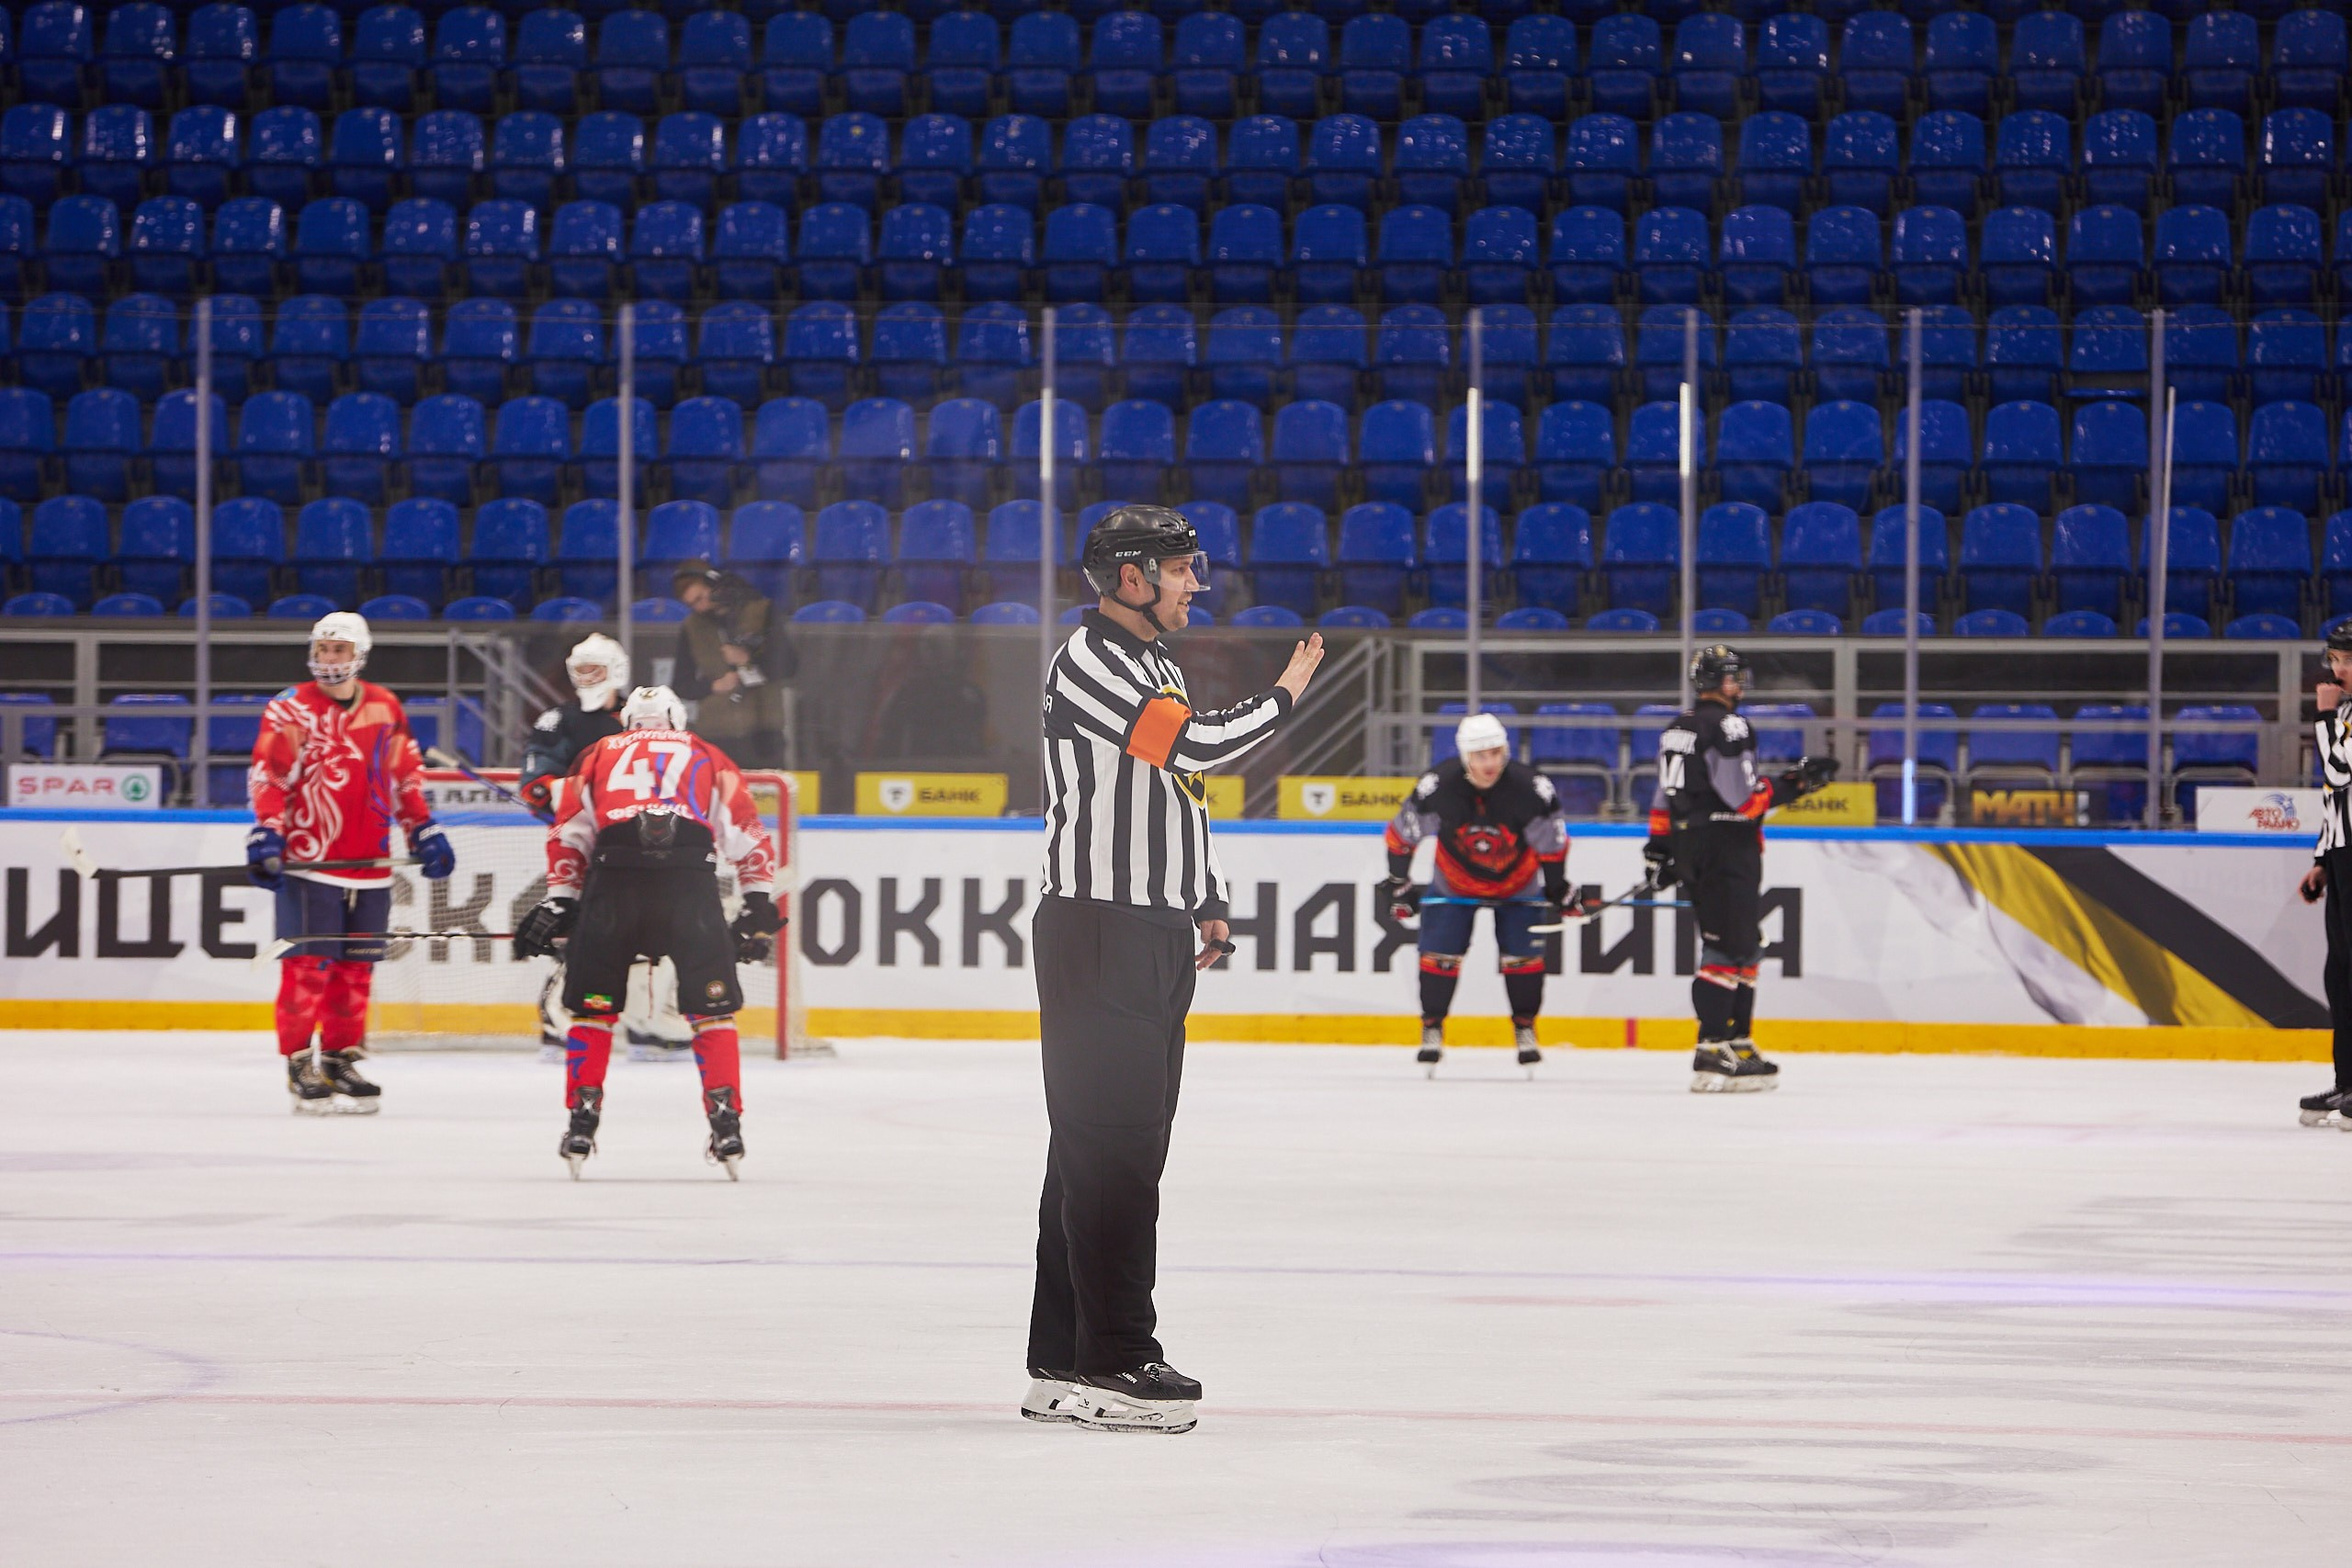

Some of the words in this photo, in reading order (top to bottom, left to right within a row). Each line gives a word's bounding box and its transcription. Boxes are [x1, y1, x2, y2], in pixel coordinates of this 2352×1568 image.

[1114, 550, 1142, 558] CCM
[605, 740, 693, 801] 47
[17, 776, 116, 795] SPAR
[1340, 792, 1401, 807] БАНК
